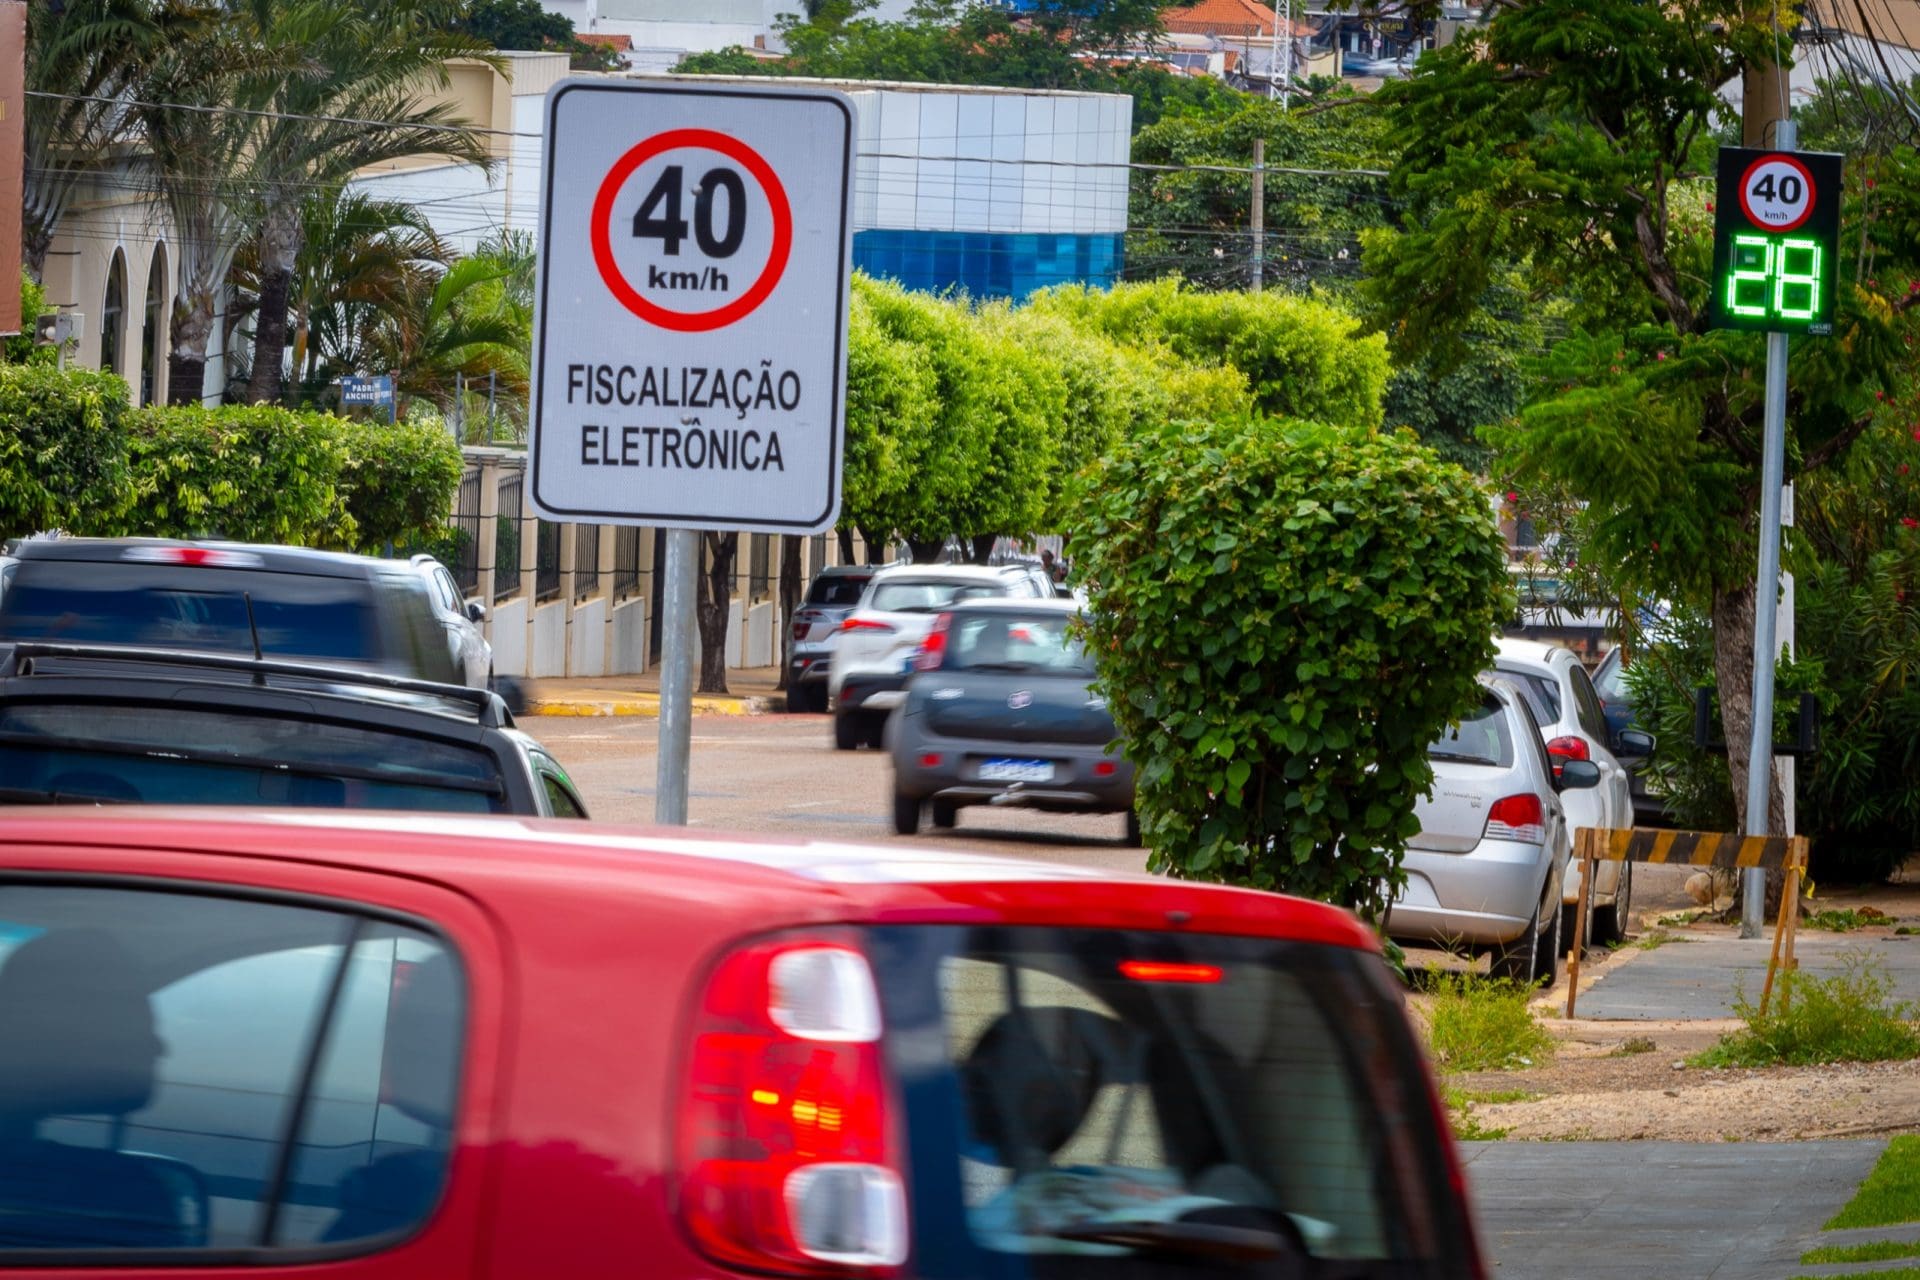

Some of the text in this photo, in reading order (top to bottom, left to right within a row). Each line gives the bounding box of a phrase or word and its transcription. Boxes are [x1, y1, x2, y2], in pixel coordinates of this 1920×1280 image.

[1752, 173, 1802, 205] 40
[632, 165, 747, 260] 40
[1764, 211, 1788, 221] km/h
[648, 264, 729, 292] km/h
[1727, 235, 1822, 320] 28
[345, 392, 375, 400] ANCHIE
[567, 359, 802, 420] FISCALIZAÇÃO
[580, 417, 785, 472] ELETRÔNICA
